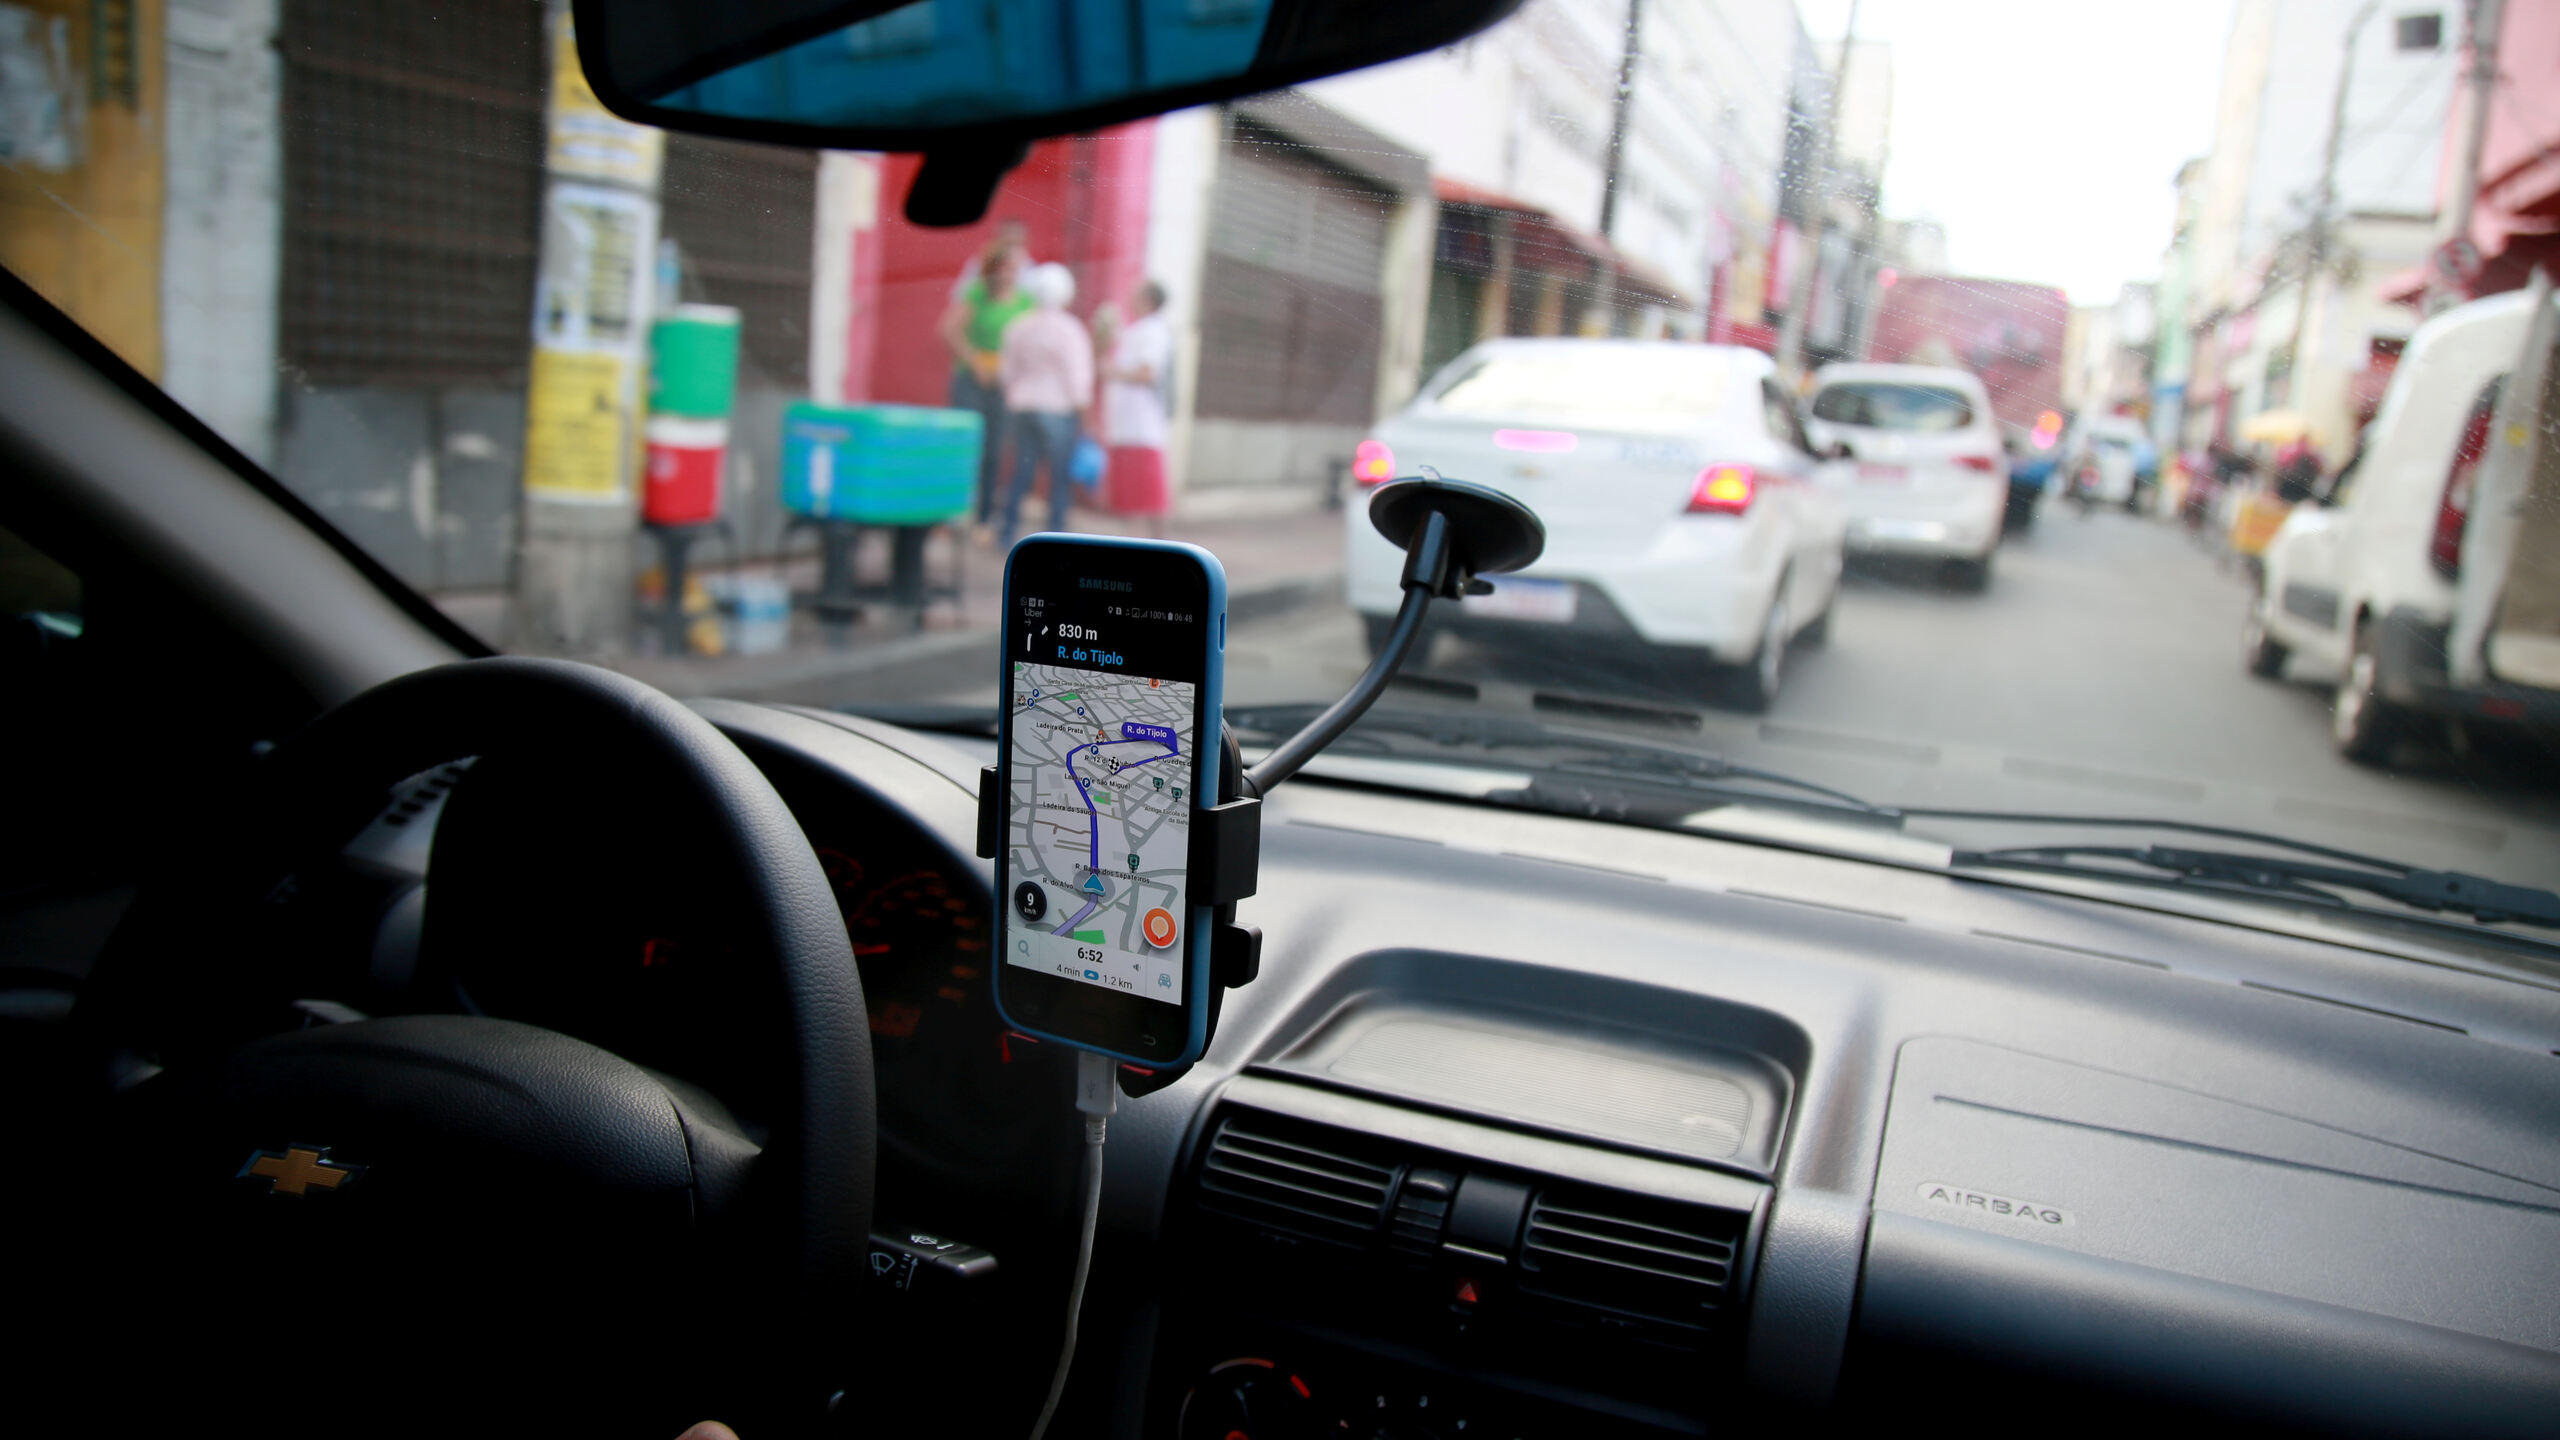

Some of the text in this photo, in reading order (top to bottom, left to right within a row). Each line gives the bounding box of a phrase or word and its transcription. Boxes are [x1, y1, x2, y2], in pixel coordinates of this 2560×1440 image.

[1079, 577, 1134, 592] SAMSUNG
[1024, 607, 1043, 617] Uber
[1174, 612, 1193, 623] 06:48
[1058, 623, 1098, 641] 830 m
[1057, 645, 1124, 667] R. do Tijolo
[1036, 722, 1057, 730] Ladeira
[1127, 725, 1168, 738] R. do Tijolo
[1109, 780, 1131, 790] Miguel
[1042, 801, 1066, 811] Ladeira
[1115, 871, 1150, 884] Sapateiros
[1027, 892, 1035, 906] 9
[1077, 947, 1104, 964] 6:52
[1056, 964, 1081, 977] 4 min
[1103, 974, 1133, 990] 1.2 km
[1928, 1186, 2064, 1226] AIRBAG
